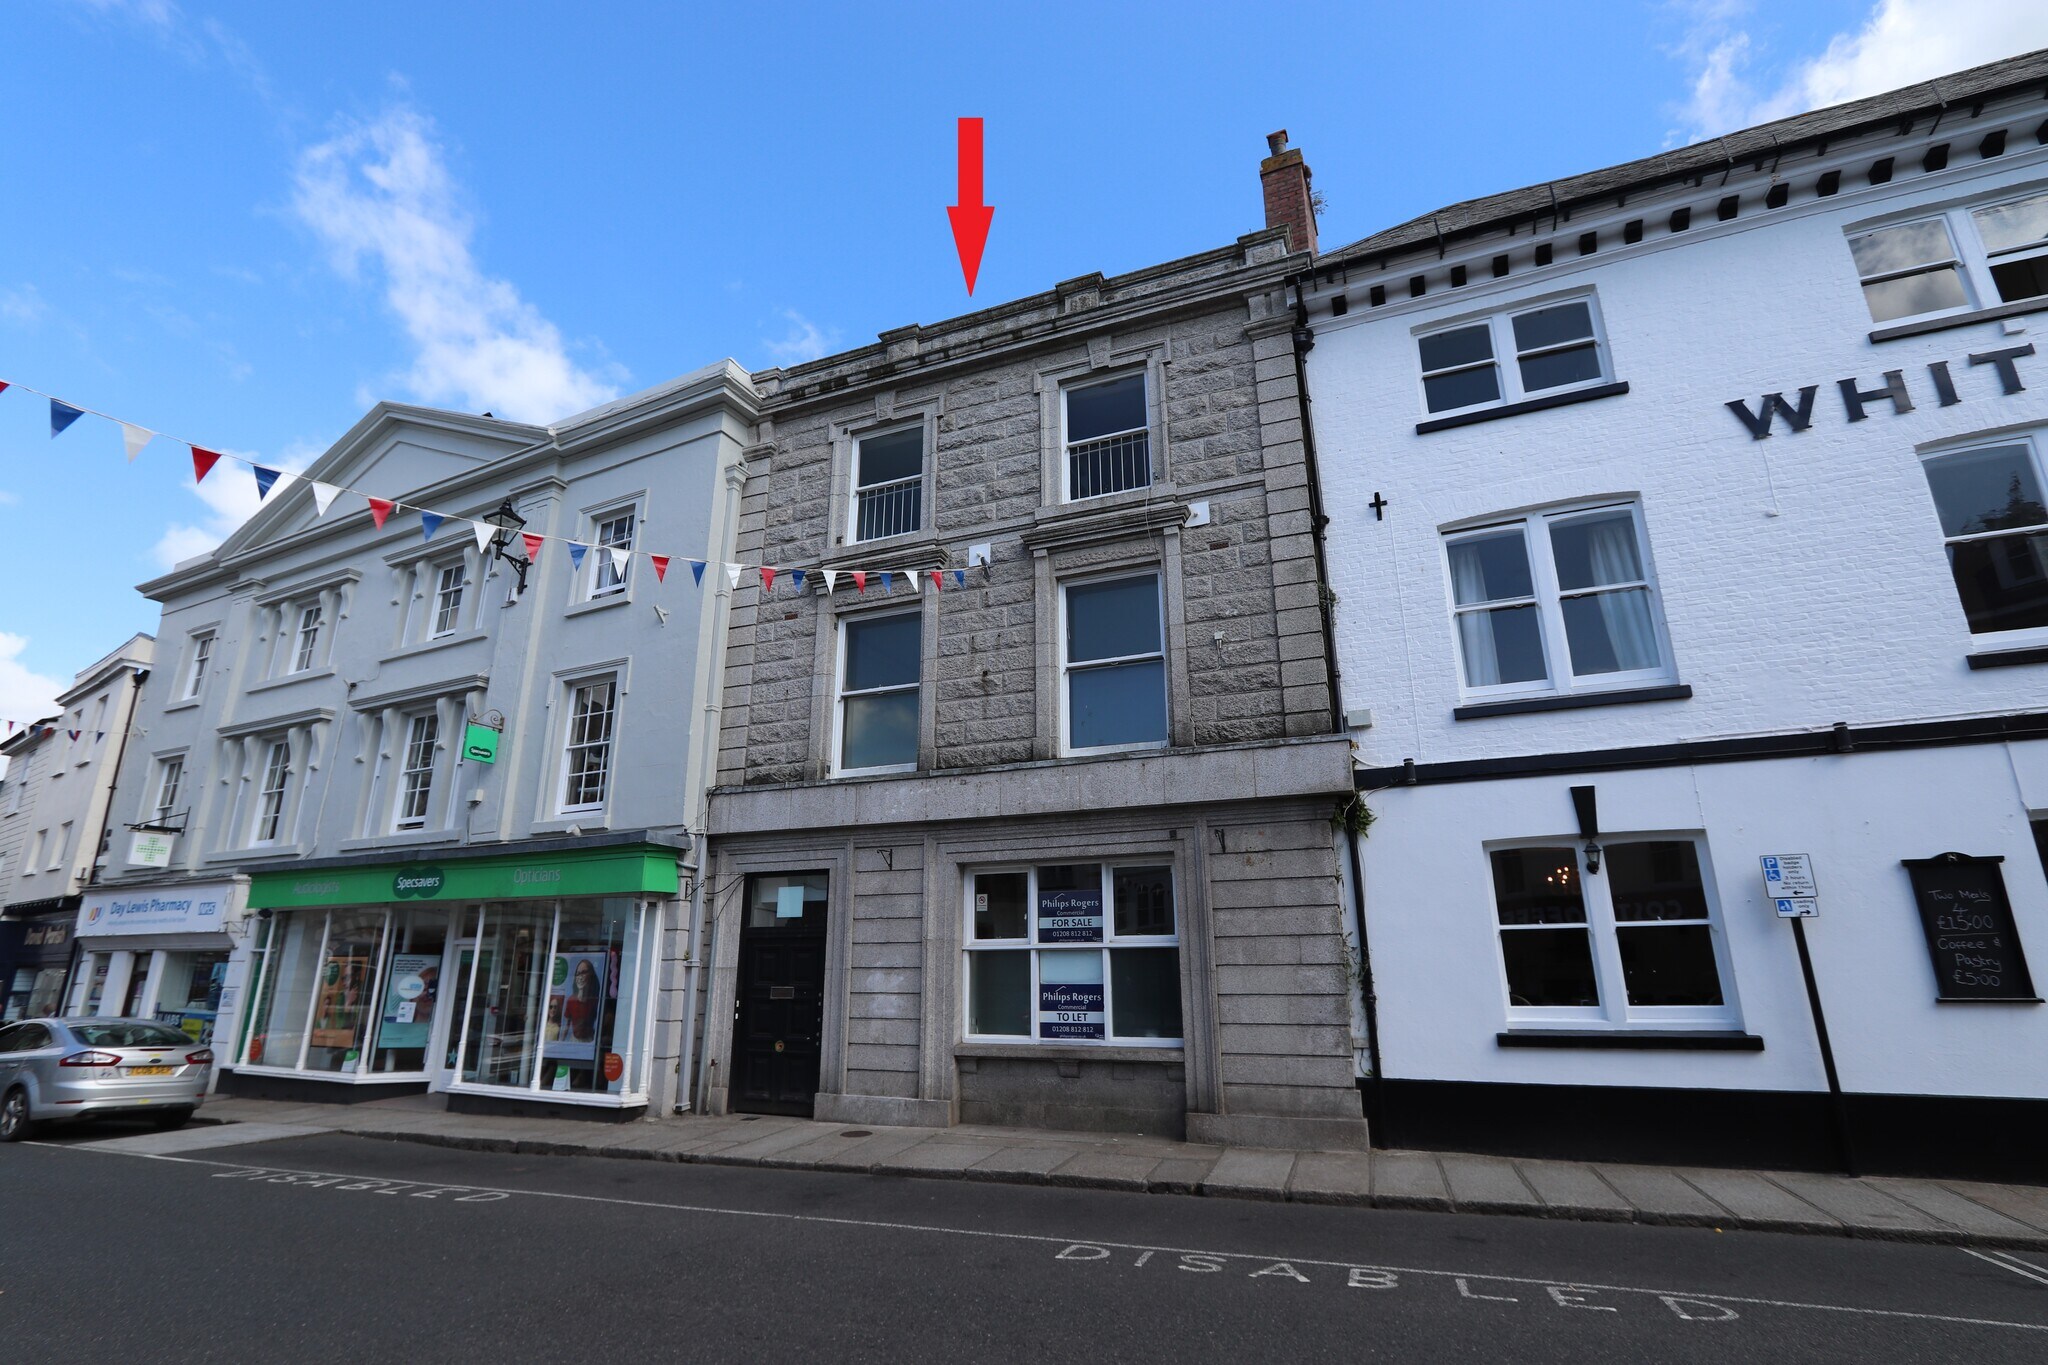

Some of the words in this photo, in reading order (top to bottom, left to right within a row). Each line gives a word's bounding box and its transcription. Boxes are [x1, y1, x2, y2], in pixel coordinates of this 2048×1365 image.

[1724, 343, 2036, 440] WHIT
[396, 875, 440, 891] Specsavers
[513, 866, 561, 885] Opticians
[1928, 890, 1953, 900] Two
[1958, 890, 1992, 901] Meals
[110, 902, 126, 917] Day
[126, 900, 149, 914] Lewis
[149, 898, 193, 914] Pharmacy
[1042, 899, 1070, 910] Philips
[1070, 899, 1099, 910] Rogers
[1052, 919, 1070, 927] FOR
[1071, 918, 1093, 927] SALE
[1937, 937, 1987, 950] Coffee
[1955, 953, 2002, 972] Pastry
[1042, 991, 1071, 1004] Philips
[1072, 992, 1102, 1004] Rogers
[1056, 1012, 1070, 1022] TO
[1072, 1012, 1089, 1022] LET
[211, 1169, 510, 1202] DISABLED
[1055, 1243, 1740, 1322] DISABLED
